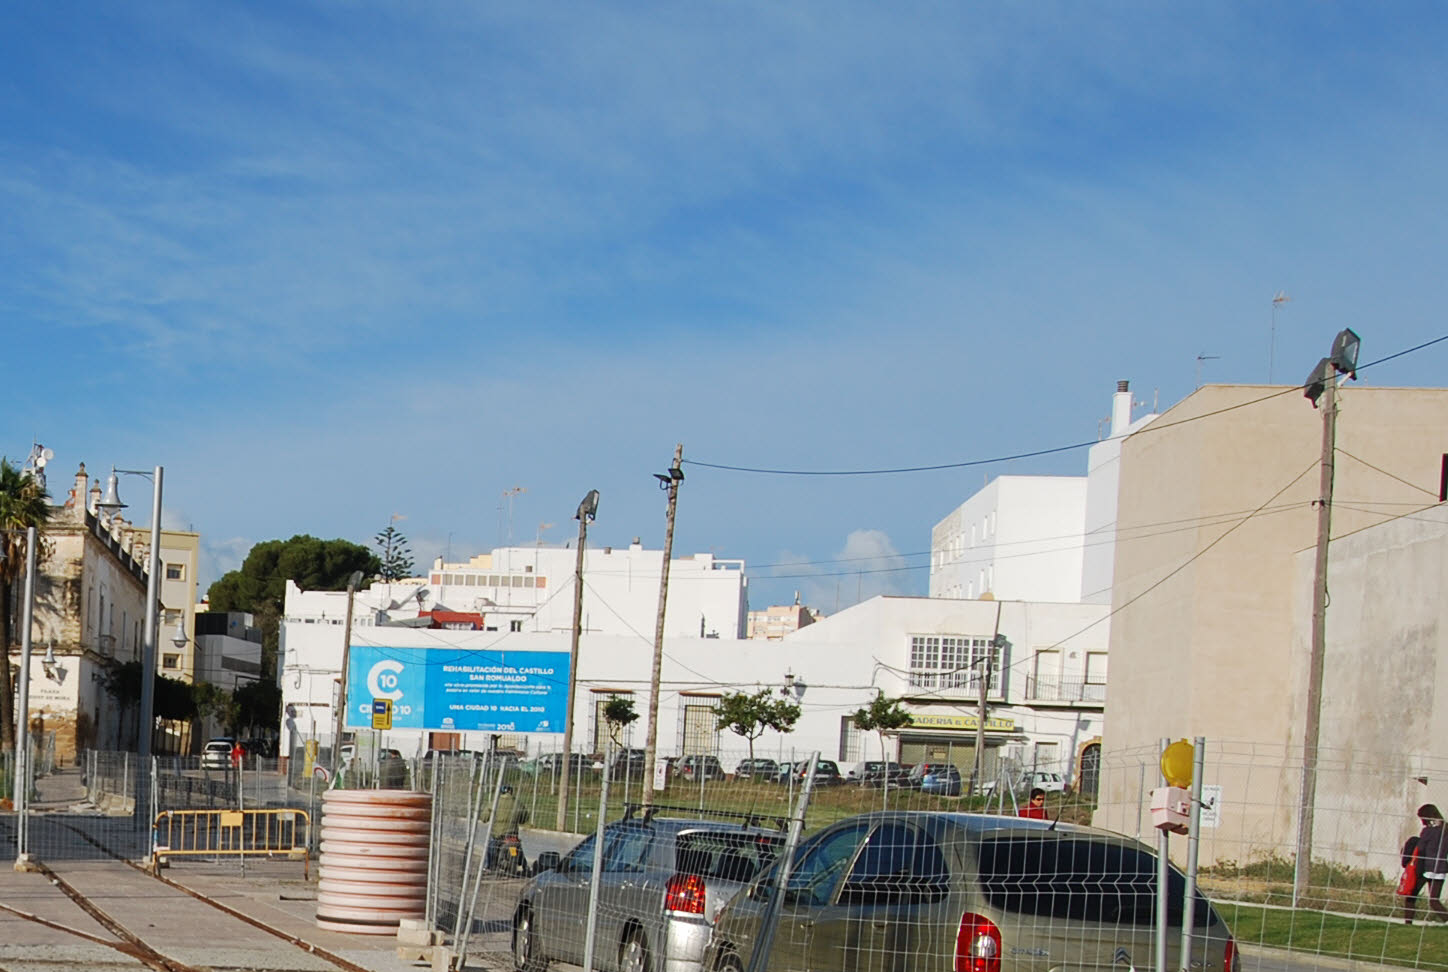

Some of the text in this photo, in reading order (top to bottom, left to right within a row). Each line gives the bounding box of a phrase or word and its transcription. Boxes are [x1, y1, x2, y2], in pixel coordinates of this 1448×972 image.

[443, 665, 503, 674] REHABILITACIÓN
[519, 667, 554, 675] CASTILLO
[379, 674, 398, 688] 10
[400, 705, 412, 715] 10
